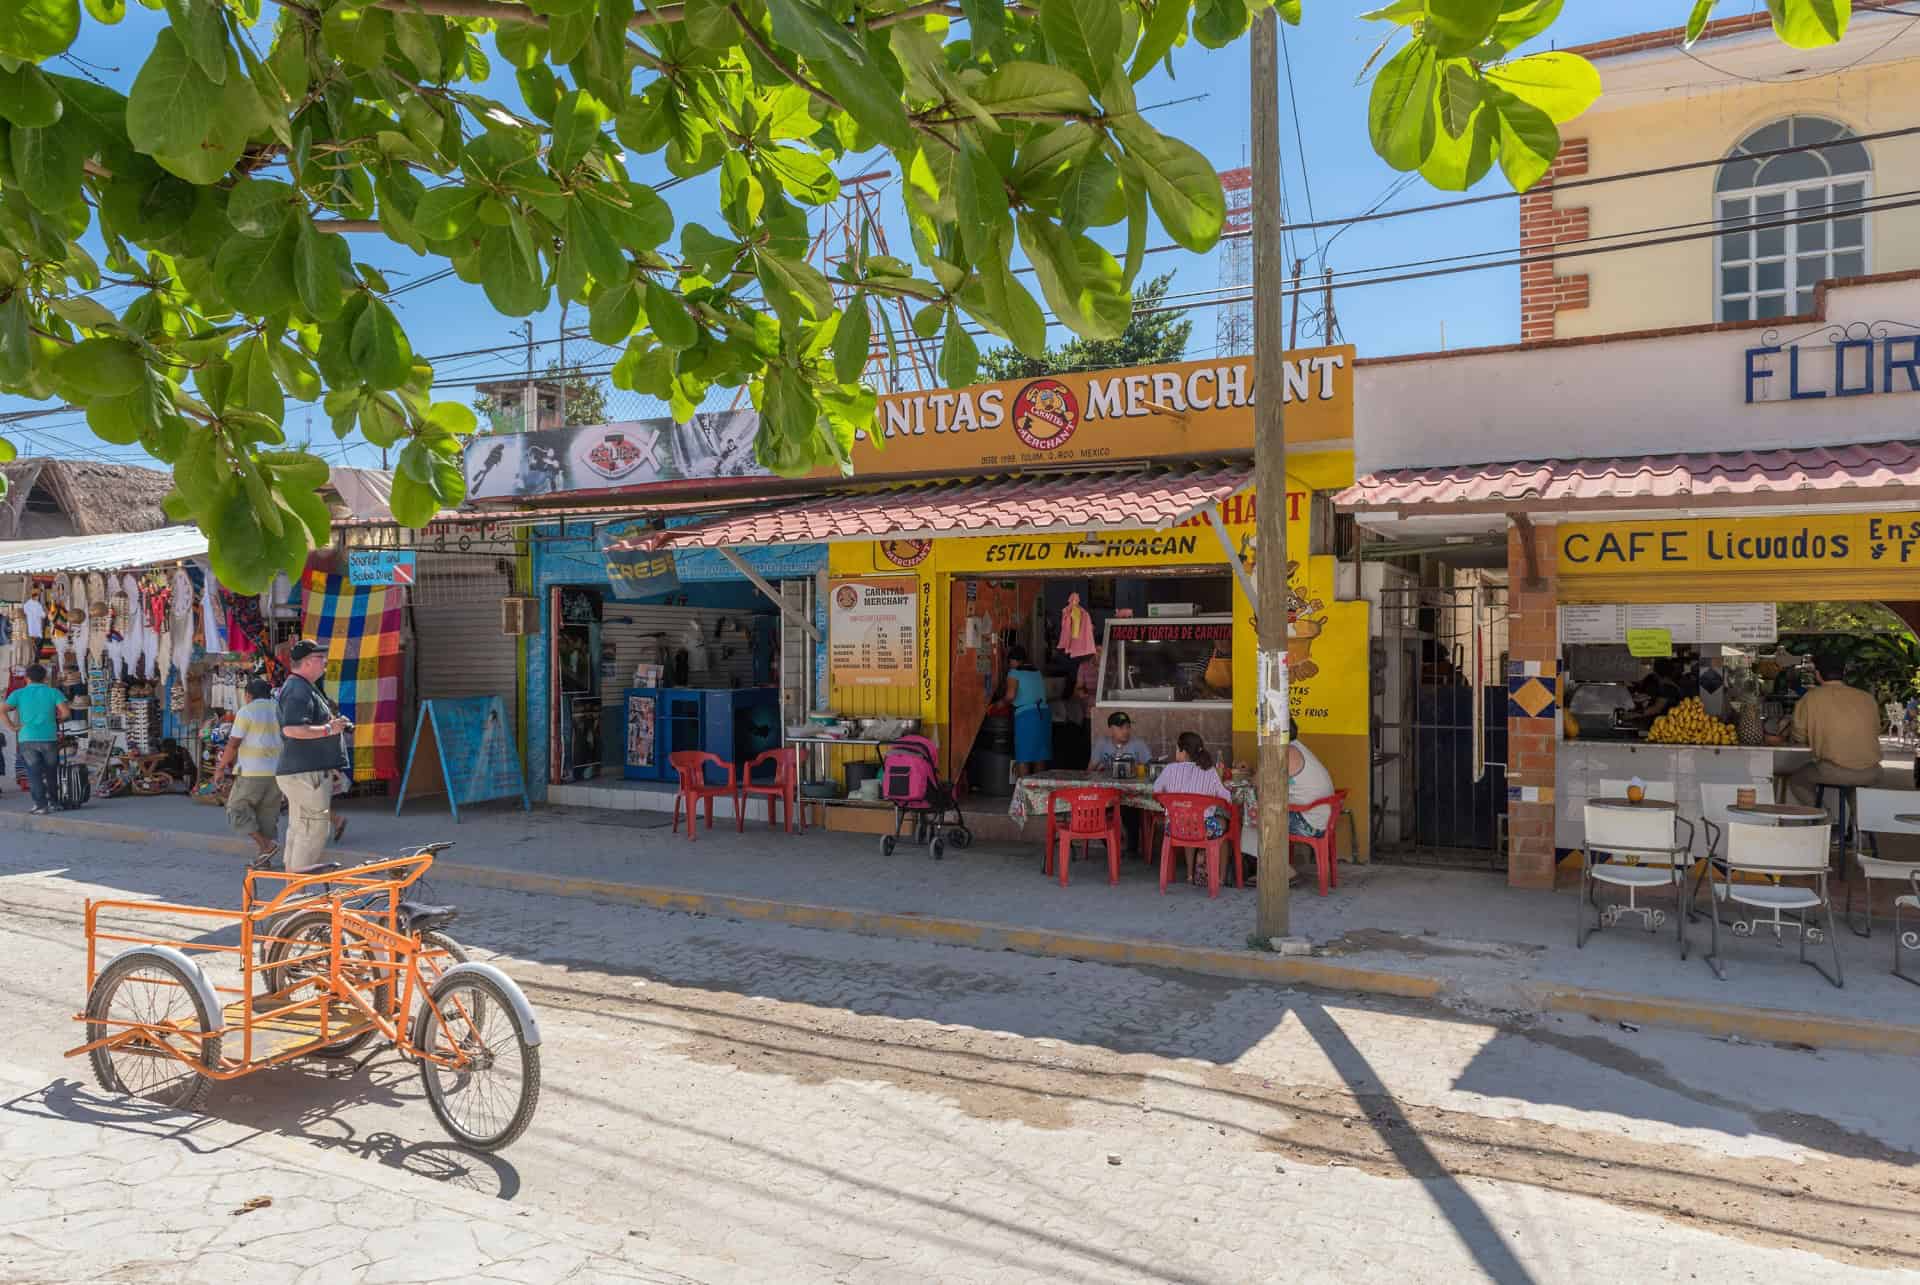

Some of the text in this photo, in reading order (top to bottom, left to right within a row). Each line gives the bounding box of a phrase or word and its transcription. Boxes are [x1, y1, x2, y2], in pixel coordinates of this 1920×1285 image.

[1745, 335, 1920, 404] FLOR
[857, 389, 1005, 440] NITAS
[1018, 420, 1075, 449] MERCHANT
[1080, 448, 1110, 458] MEXICO
[986, 536, 1197, 562] ESTILO MCHOACAN
[1564, 528, 1849, 563] CAFE Licuados
[864, 597, 909, 606] MERCHANT
[865, 587, 905, 597] CARNITAS
[922, 583, 932, 701] BIENVENIDOS
[1148, 626, 1179, 640] TORTAS
[1182, 626, 1193, 640] DE
[1195, 626, 1232, 640] CARNITA
